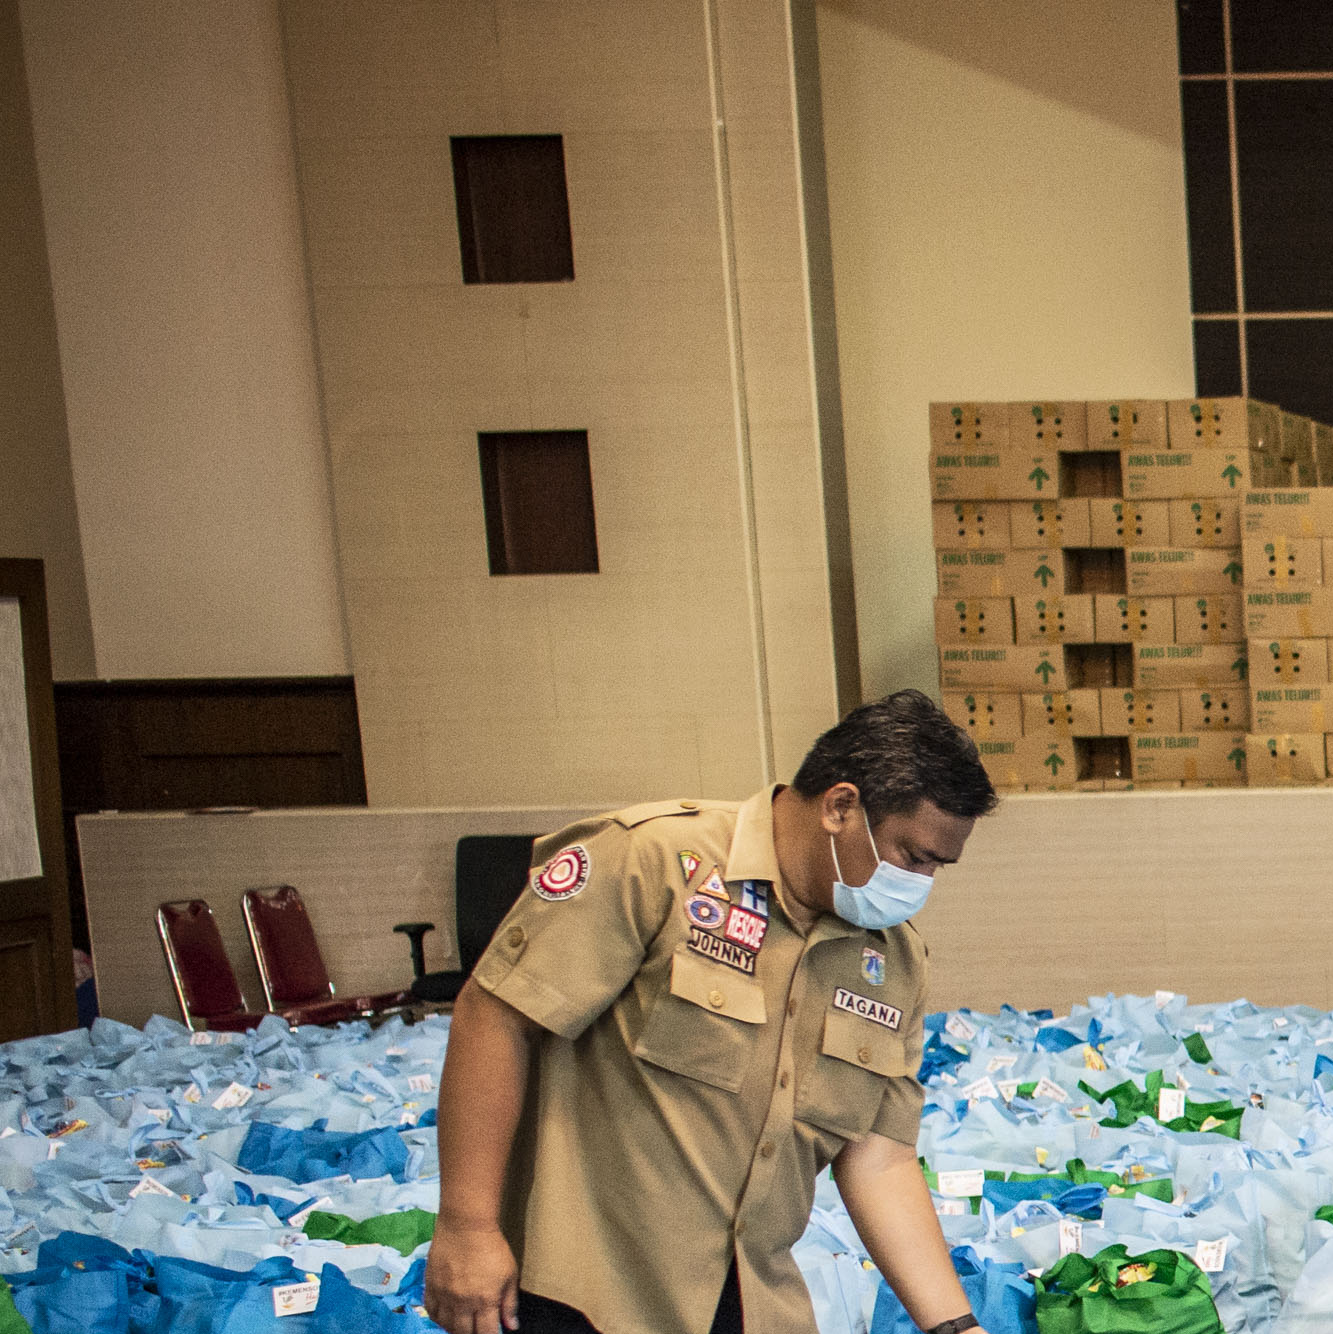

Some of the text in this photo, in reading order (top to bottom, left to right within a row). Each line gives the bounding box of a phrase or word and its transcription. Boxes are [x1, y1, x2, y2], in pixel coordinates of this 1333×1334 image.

[728, 911, 767, 949] RESCUE
[694, 931, 753, 969] JOHNNY
[839, 991, 897, 1027] TAGANA
[279, 1286, 318, 1297] #KEMENSO
